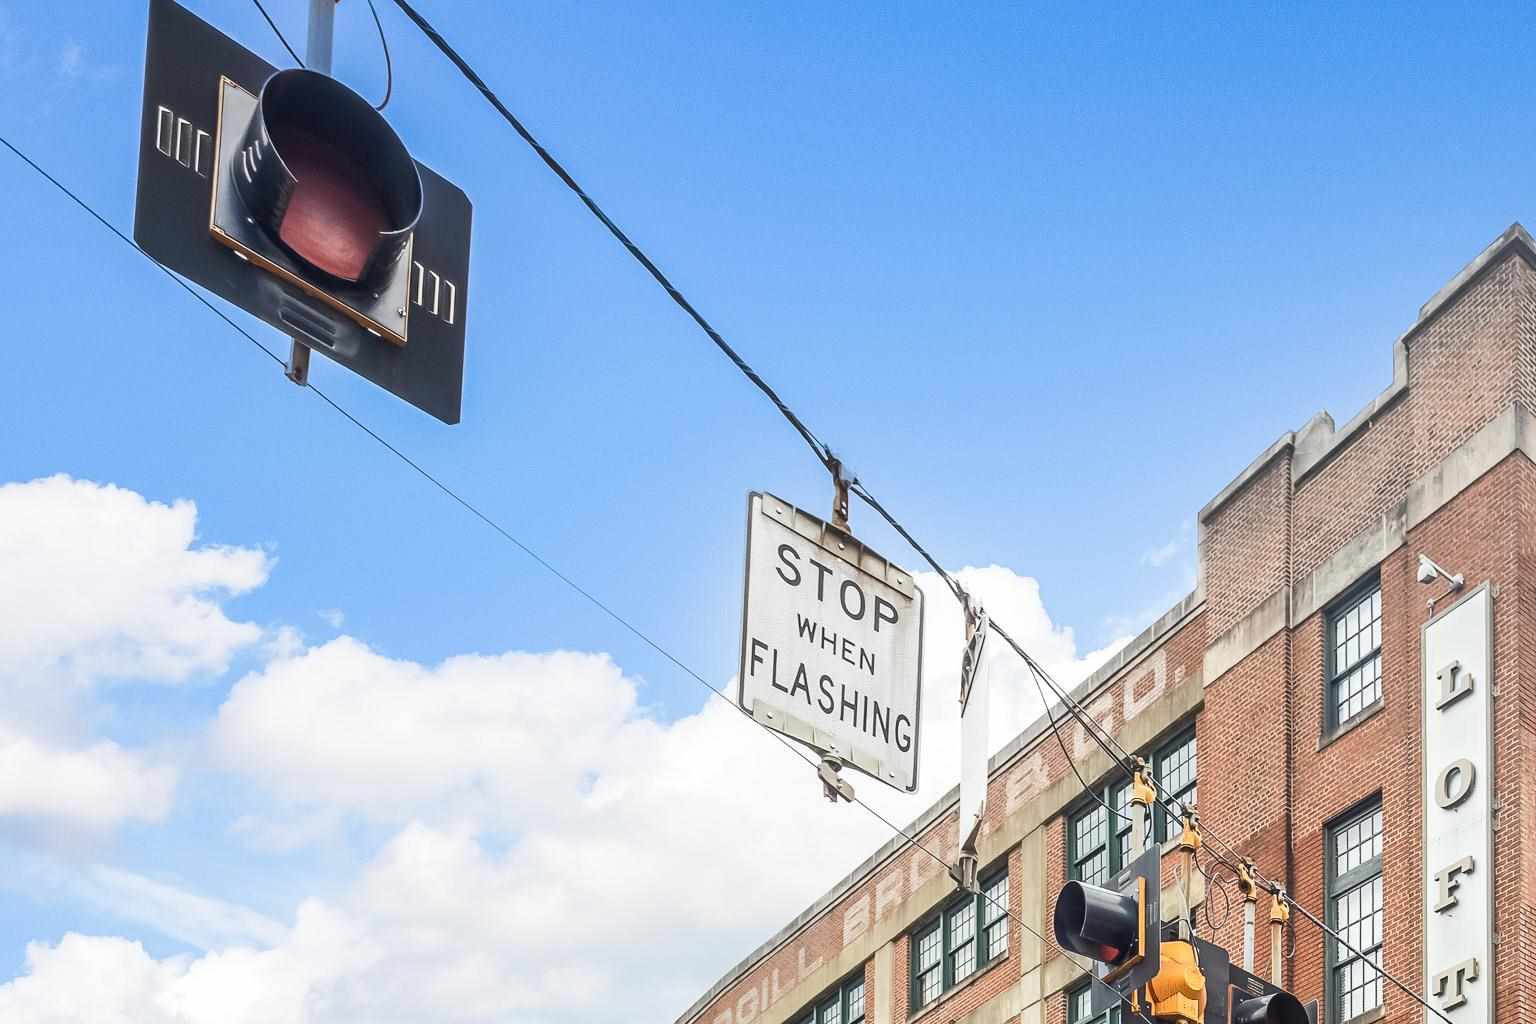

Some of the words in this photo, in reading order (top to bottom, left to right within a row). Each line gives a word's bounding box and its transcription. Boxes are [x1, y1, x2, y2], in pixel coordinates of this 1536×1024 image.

[776, 543, 899, 633] STOP
[797, 613, 876, 676] WHEN
[750, 637, 911, 753] FLASHING
